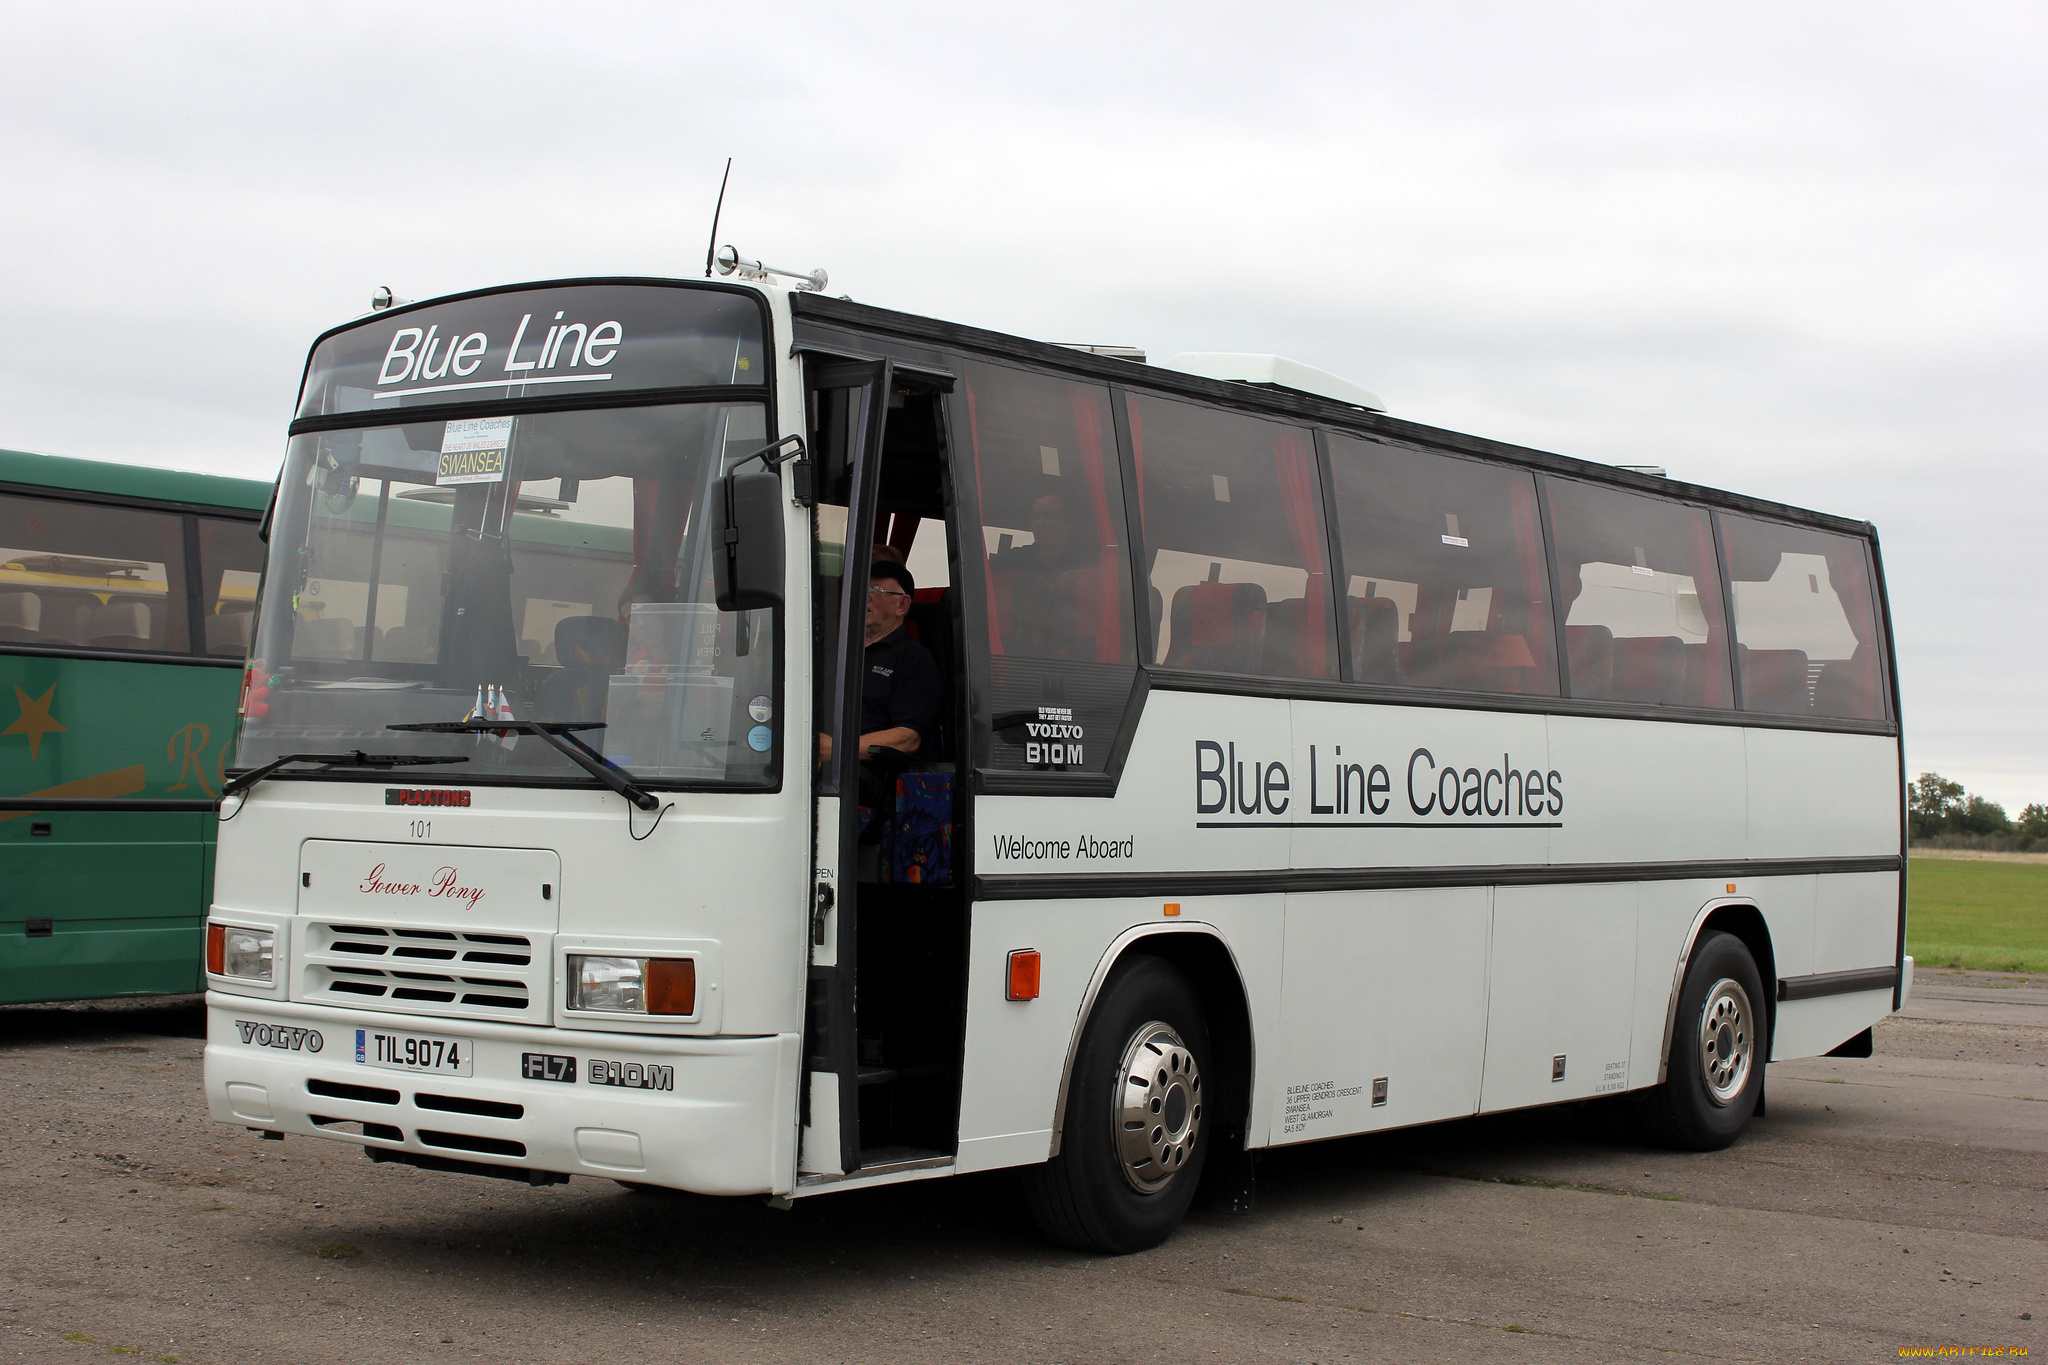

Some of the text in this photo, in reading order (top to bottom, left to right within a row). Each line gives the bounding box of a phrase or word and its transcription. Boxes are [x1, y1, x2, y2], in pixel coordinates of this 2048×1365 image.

[377, 310, 624, 386] Blue Line
[446, 418, 511, 434] Blue Line Coaches
[452, 442, 467, 451] HEART
[487, 439, 507, 449] EXPRESS
[440, 451, 502, 475] SWANSEA
[1025, 722, 1084, 739] VOLVO
[1195, 740, 1564, 816] Blue Line Coaches
[398, 789, 470, 806] PLAXTONS
[410, 820, 431, 838] 101
[993, 834, 1134, 860] Welcome Aboard
[815, 868, 834, 878] PEN
[359, 862, 486, 911] Gower Pony
[234, 1019, 324, 1053] VOLVO
[356, 1053, 365, 1062] GB
[374, 1034, 460, 1070] TIL9074
[528, 1055, 568, 1080] FL7
[1286, 1084, 1310, 1095] BLUELINE
[1293, 1093, 1311, 1104] UPPER
[1311, 1090, 1336, 1101] GENDROS
[1284, 1114, 1300, 1124] WEST
[1283, 1124, 1295, 1134] SA5
